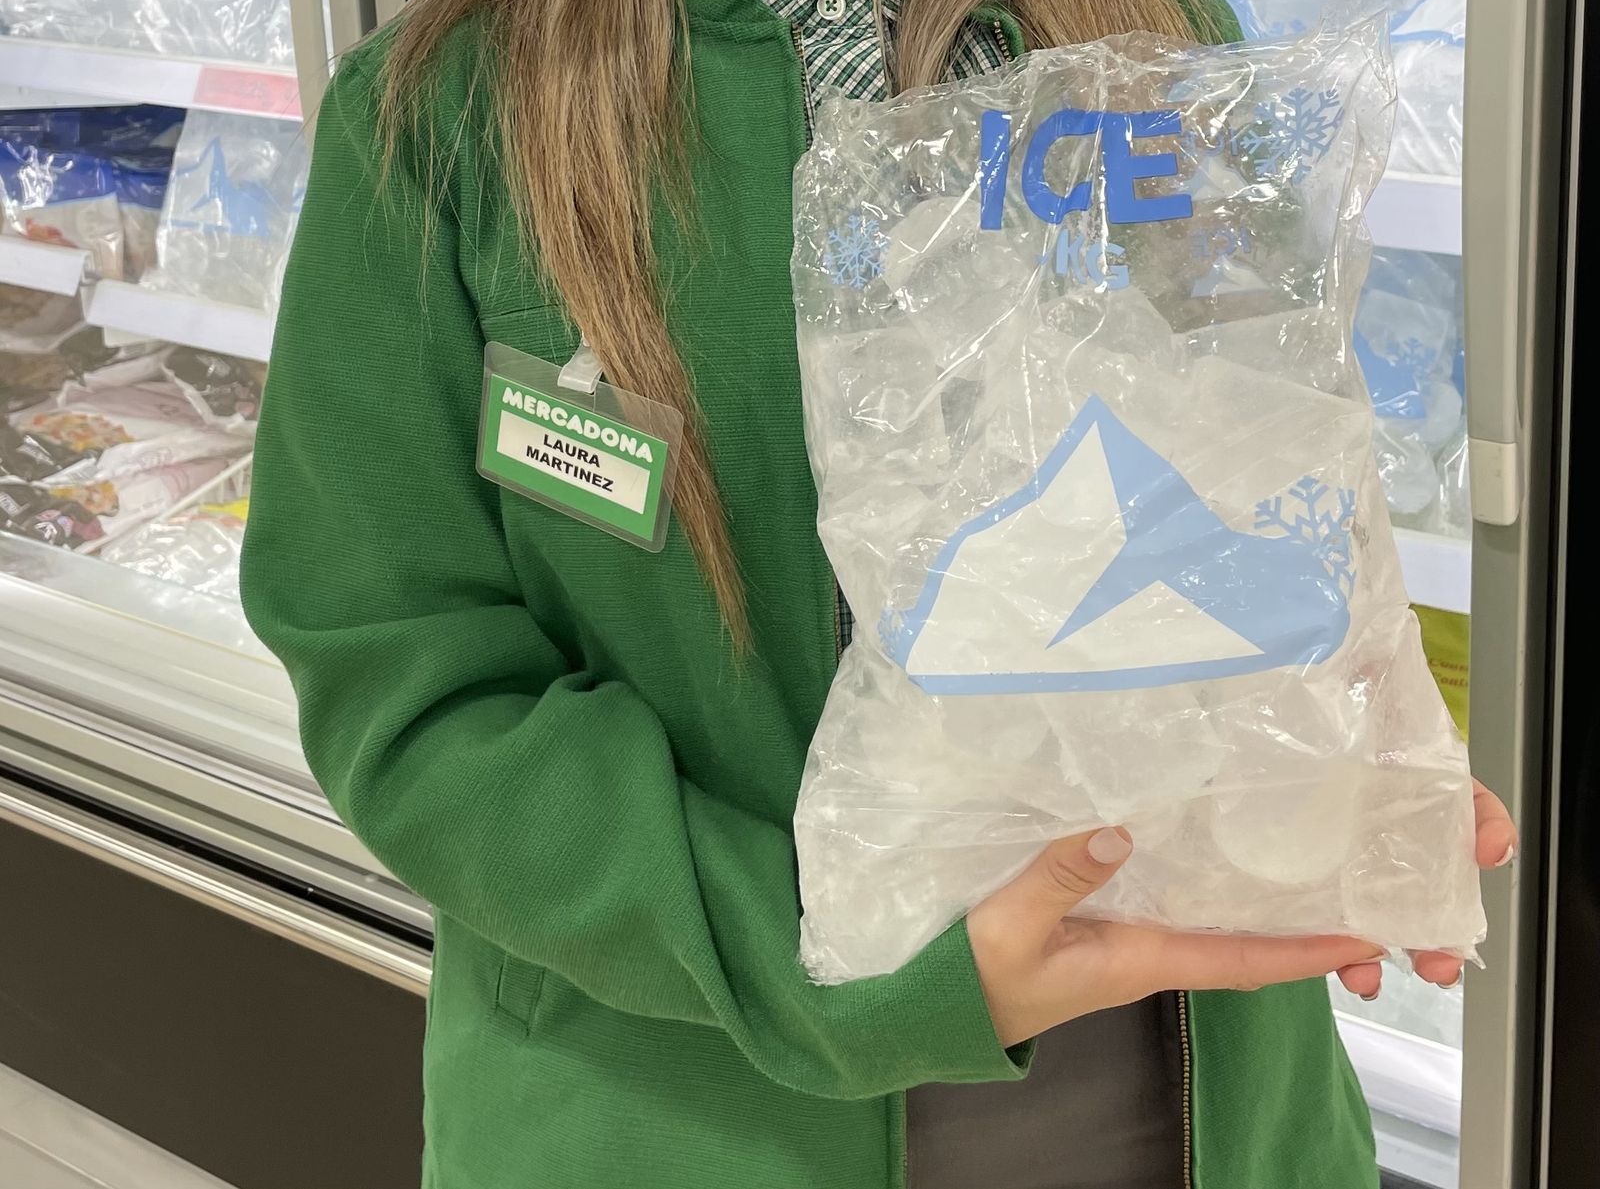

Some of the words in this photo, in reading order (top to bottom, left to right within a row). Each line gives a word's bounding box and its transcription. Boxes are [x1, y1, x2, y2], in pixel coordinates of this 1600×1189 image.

[980, 108, 1193, 230] ICE
[1055, 228, 1130, 290] KG
[502, 386, 653, 463] MERCADONA
[543, 434, 600, 468] LAURA
[526, 445, 614, 492] MARTINEZ
